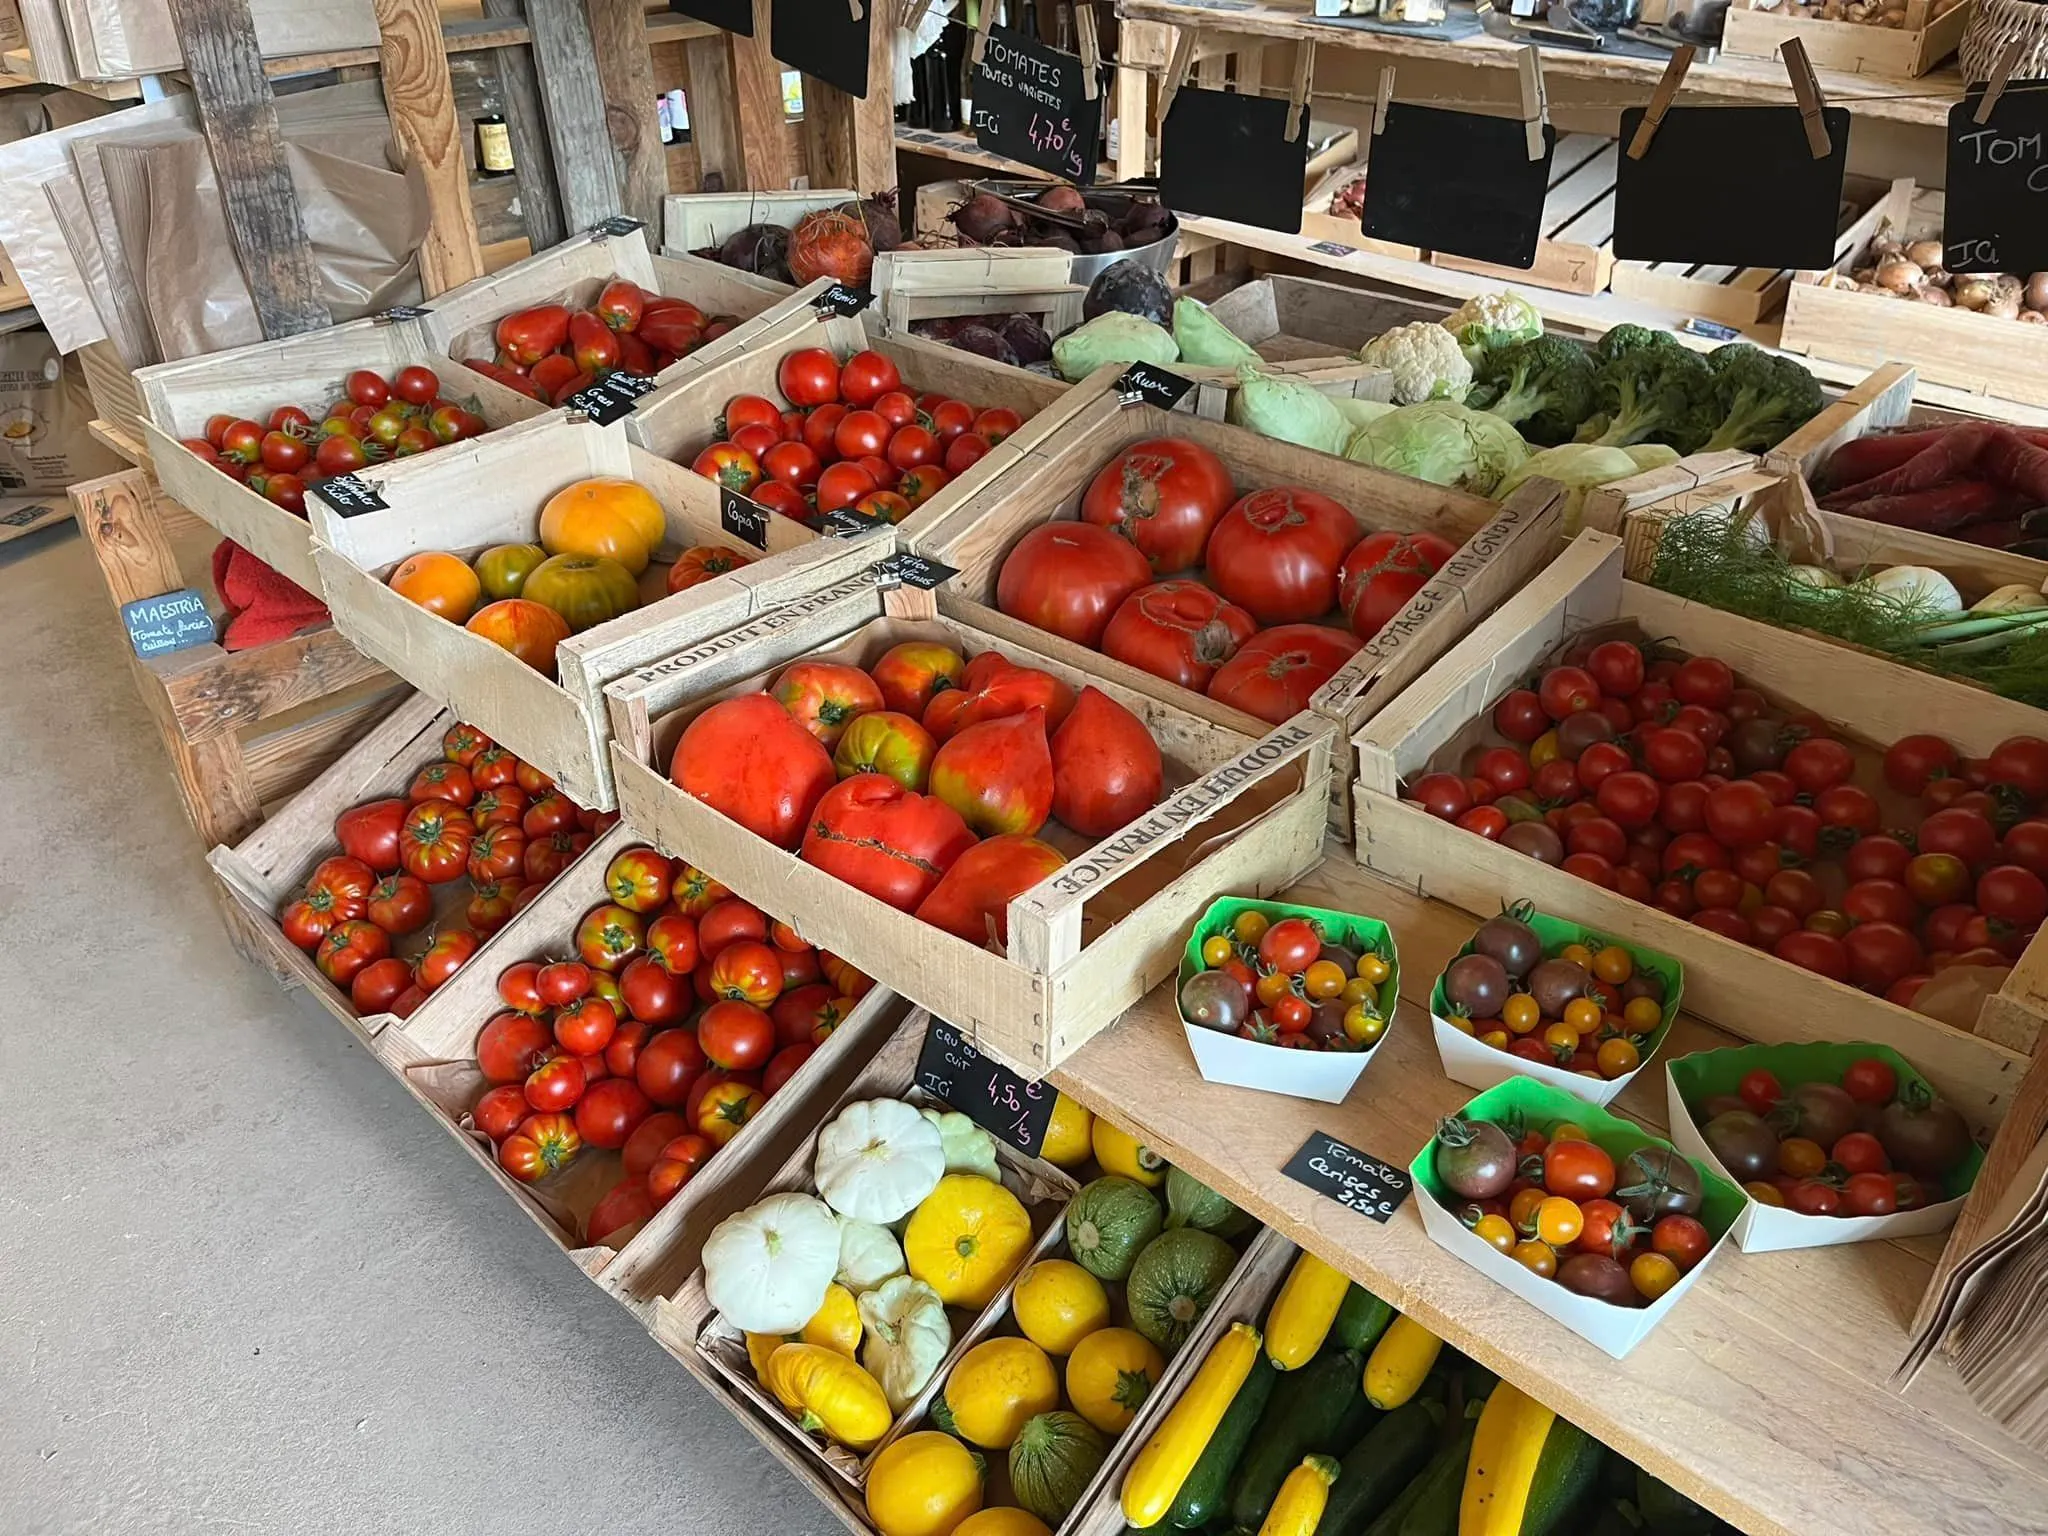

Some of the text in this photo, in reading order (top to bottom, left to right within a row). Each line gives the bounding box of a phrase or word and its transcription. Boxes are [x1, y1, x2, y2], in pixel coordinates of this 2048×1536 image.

[981, 62, 1014, 87] TOUTES
[988, 36, 1061, 87] TOMATES
[727, 499, 755, 532] Copia
[636, 570, 878, 684] PRODUIT EN FRANC
[1052, 725, 1313, 896] PRODUIT EN FRANCE
[935, 1028, 958, 1047] CRU
[1308, 1156, 1381, 1200] Cerises
[1324, 1140, 1404, 1189] Tomates
